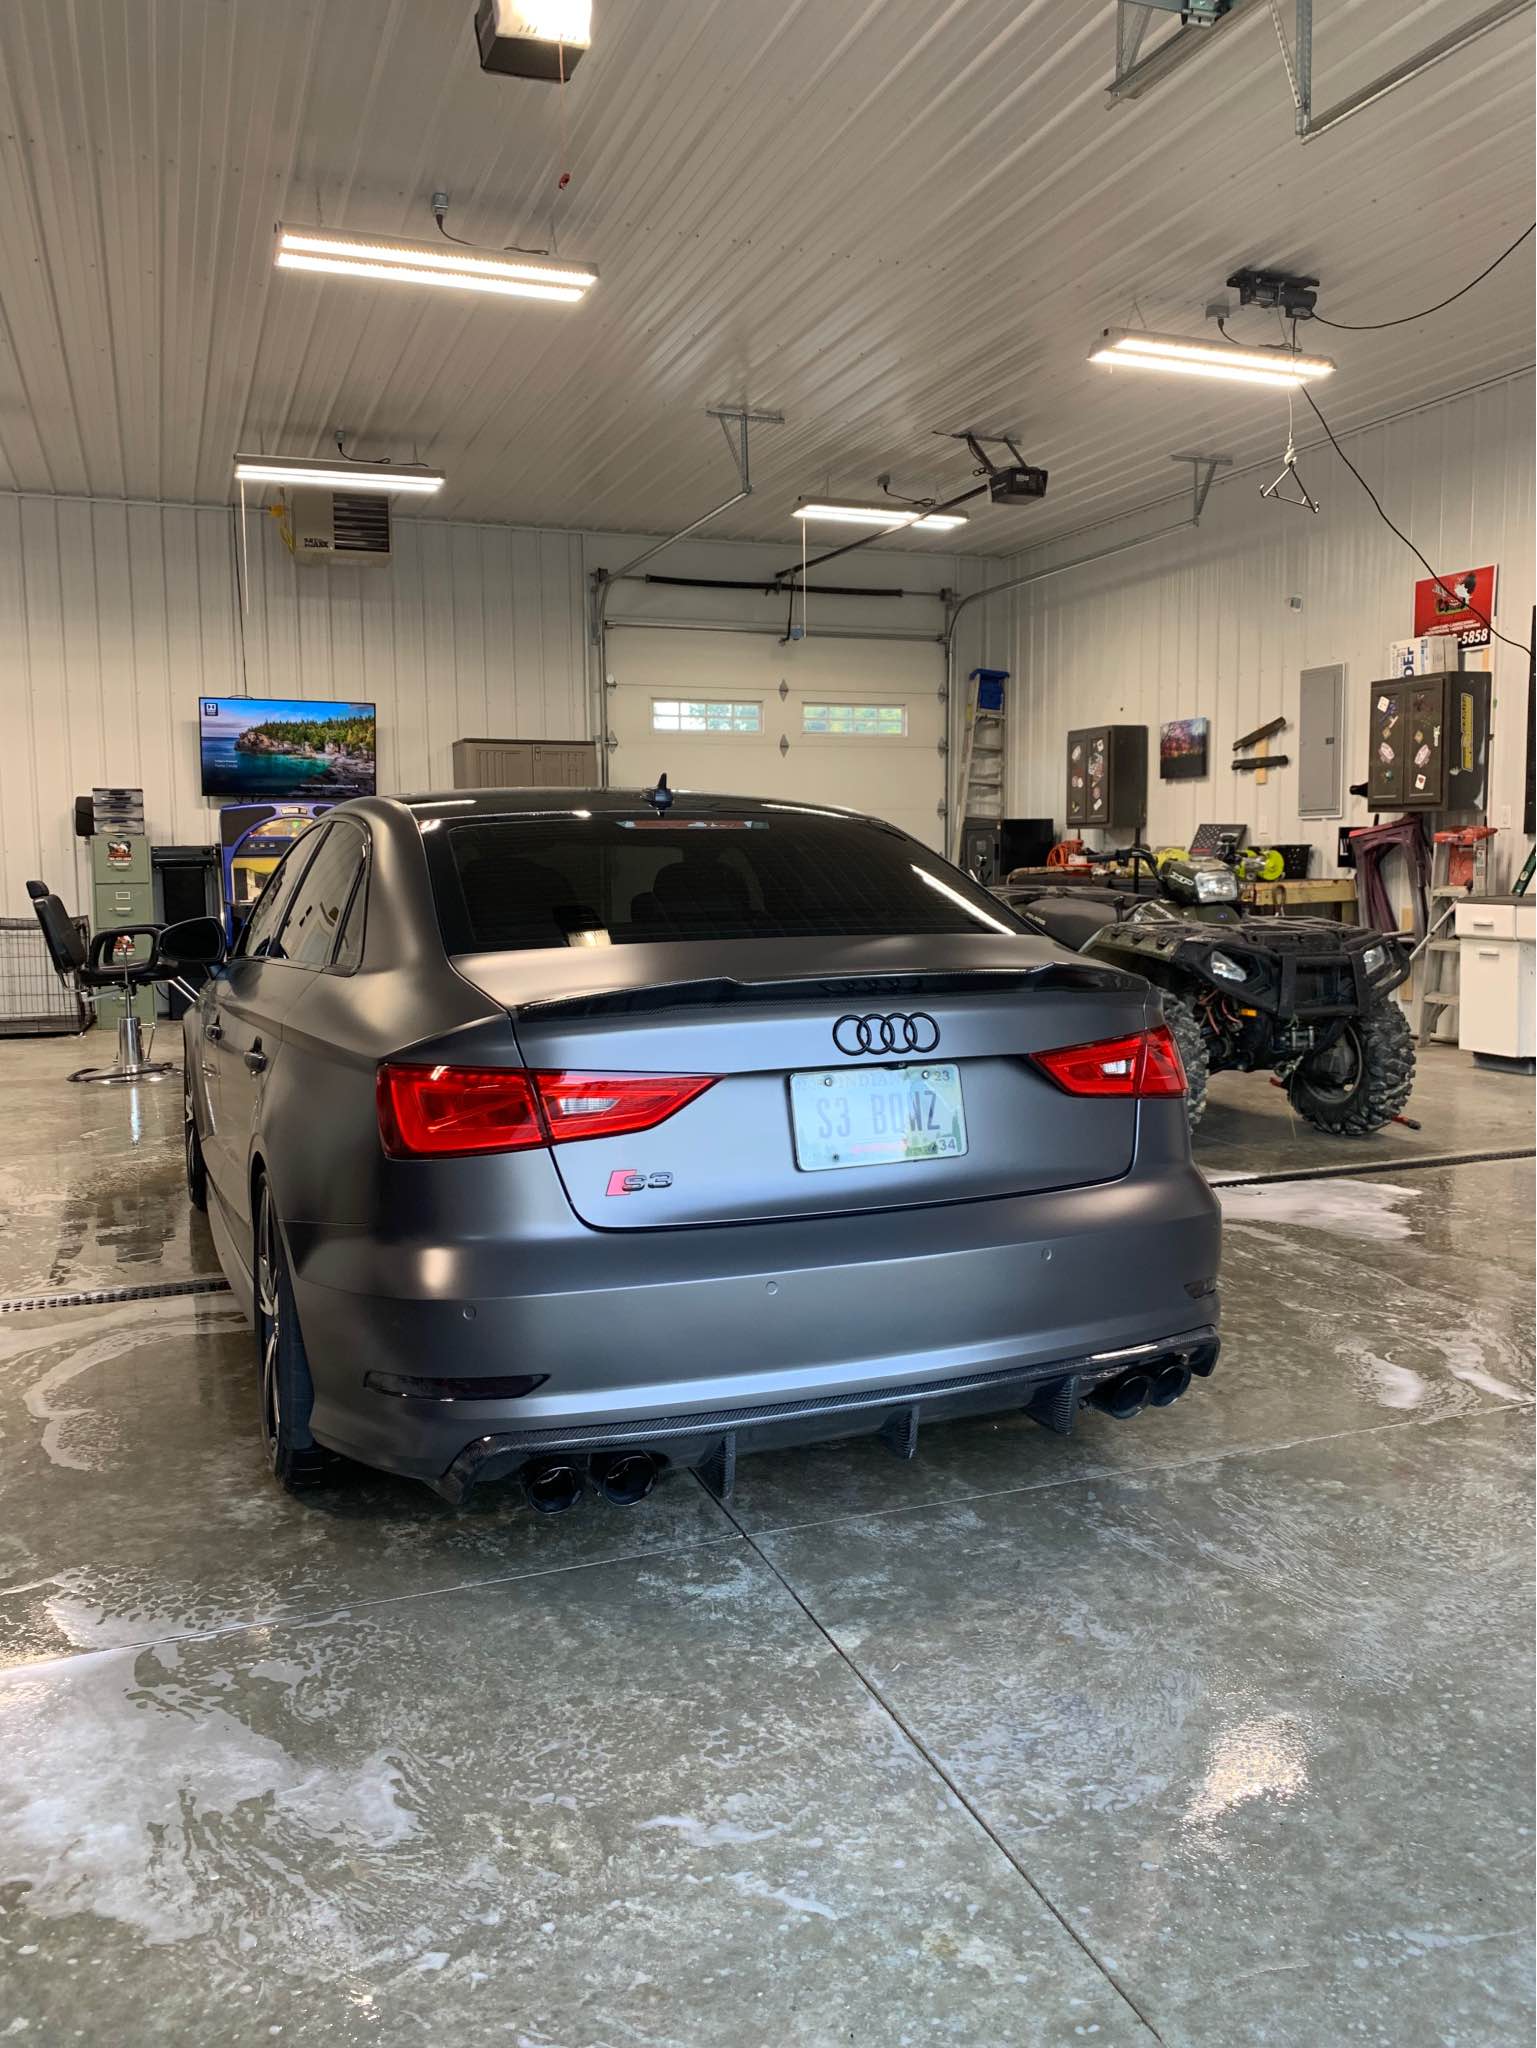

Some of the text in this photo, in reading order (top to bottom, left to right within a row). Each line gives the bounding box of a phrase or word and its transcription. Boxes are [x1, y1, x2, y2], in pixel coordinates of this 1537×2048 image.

[934, 1070, 950, 1081] 23
[816, 1097, 851, 1139] S3
[939, 1138, 956, 1151] 34
[622, 1171, 673, 1192] S3
